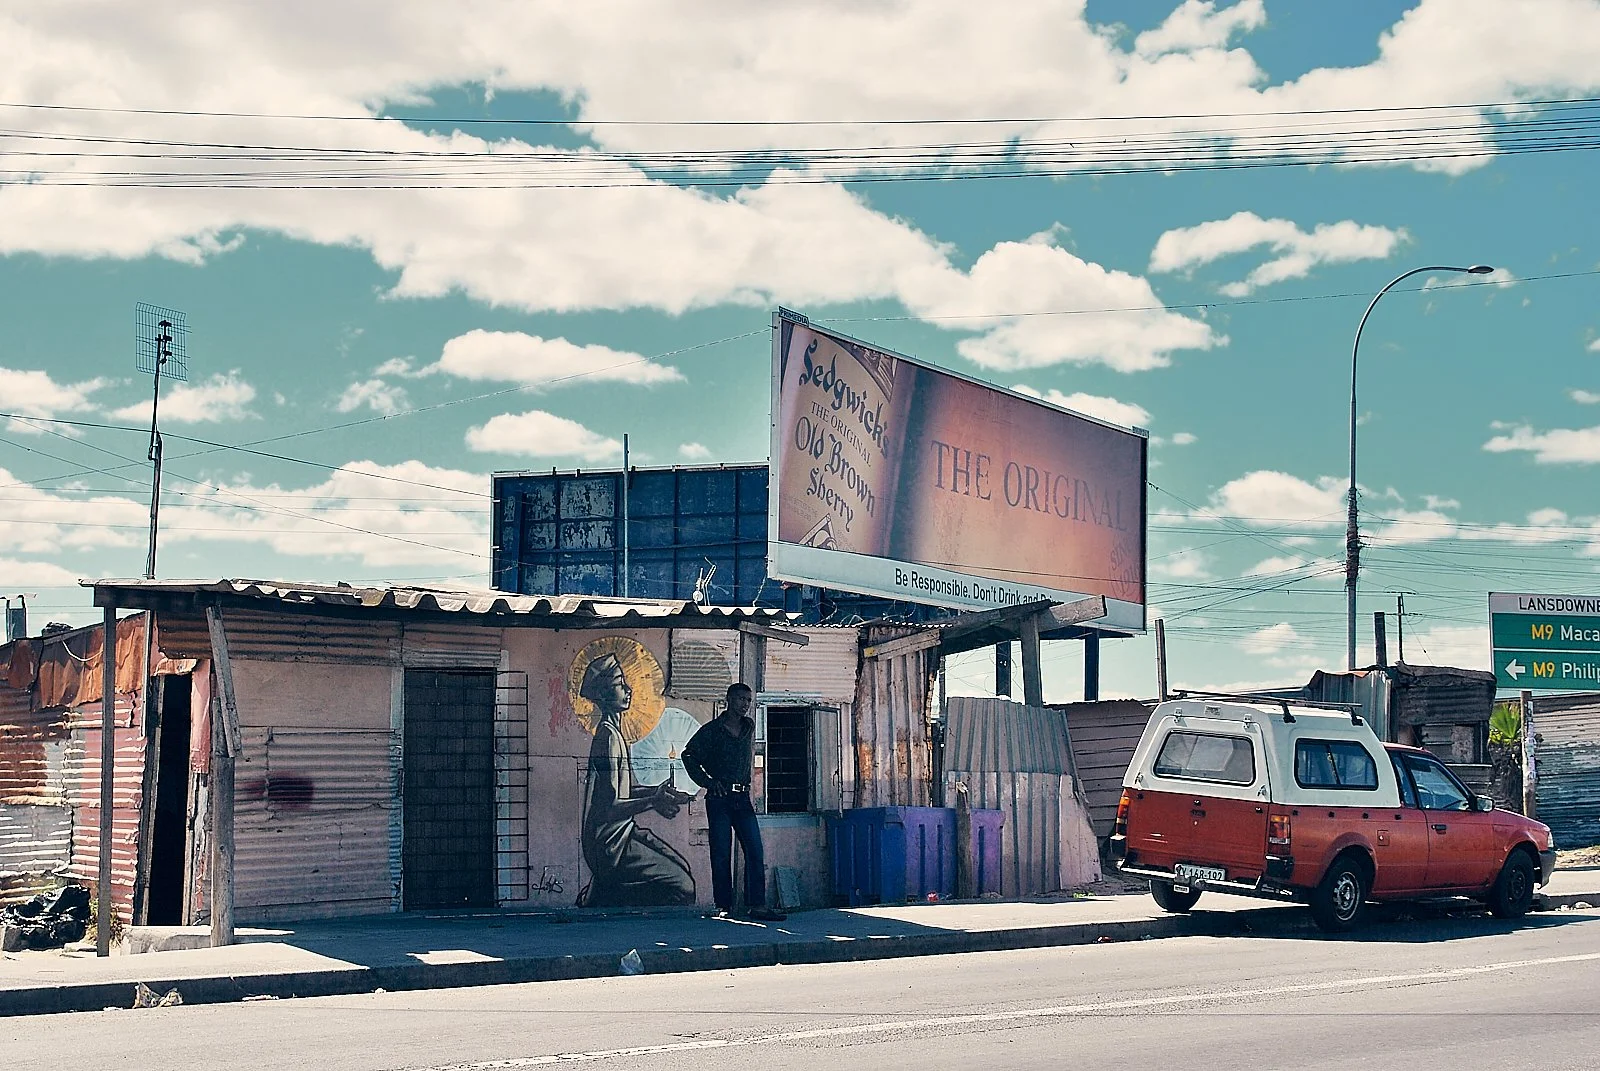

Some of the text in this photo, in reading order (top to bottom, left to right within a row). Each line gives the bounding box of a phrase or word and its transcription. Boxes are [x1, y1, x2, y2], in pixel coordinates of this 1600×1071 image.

[799, 338, 890, 459] Sedgwick's
[795, 416, 876, 518] Old Brown
[811, 401, 872, 467] THE ORIGINAL
[806, 467, 854, 533] Sherry
[931, 439, 1128, 531] THE ORIGINAL
[895, 567, 909, 587] Be
[911, 570, 971, 599] Responsible.
[973, 582, 997, 601] Don't
[999, 587, 1022, 606] Drink
[1023, 592, 1039, 605] and
[1531, 624, 1554, 640] M9
[1533, 662, 1555, 678] M9
